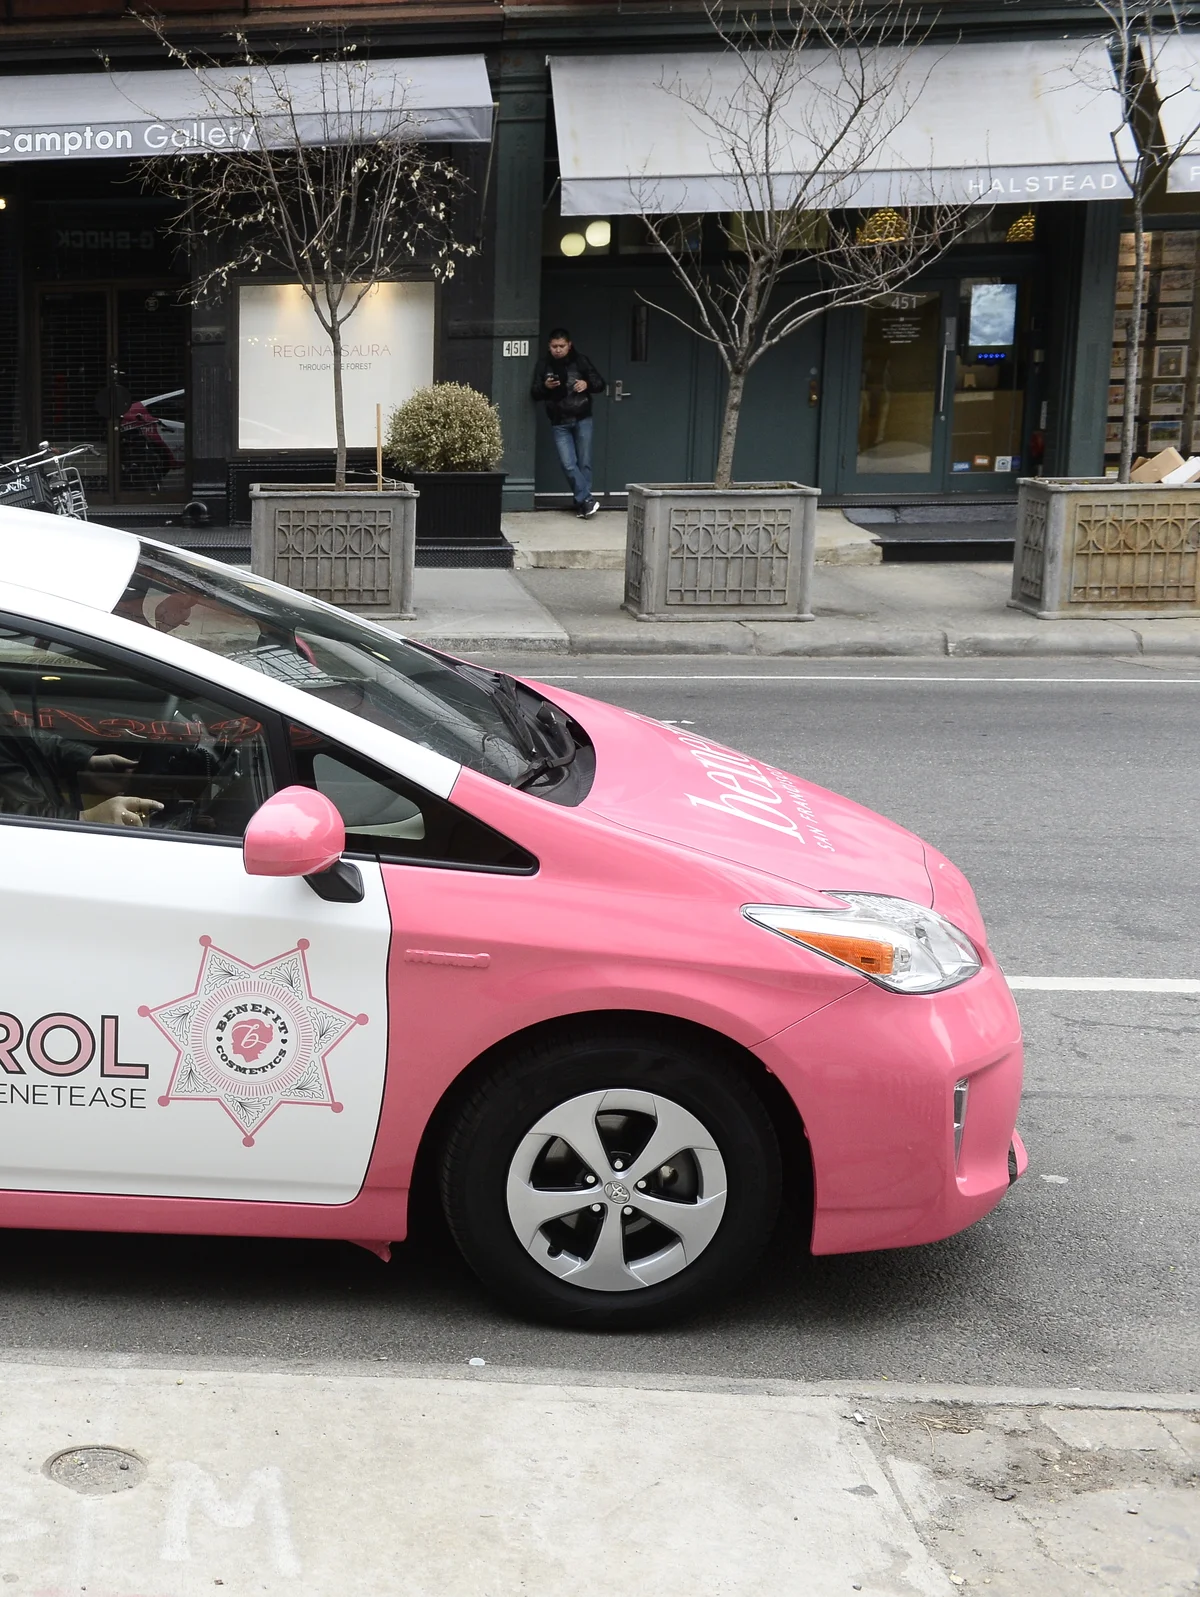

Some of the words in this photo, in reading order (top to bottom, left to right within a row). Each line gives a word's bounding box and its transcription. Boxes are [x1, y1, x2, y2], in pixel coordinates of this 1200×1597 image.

[143, 123, 255, 153] Gallery
[968, 173, 1118, 194] HALSTEAD
[891, 295, 917, 309] 451
[273, 344, 333, 358] REGINA
[340, 343, 392, 357] SAURA
[504, 341, 528, 356] 451
[299, 363, 331, 371] THROUGH
[346, 362, 372, 370] FOREST
[806, 825, 836, 853] SAN
[215, 1003, 288, 1035] BENEFIT
[216, 1045, 287, 1075] COSMETICS
